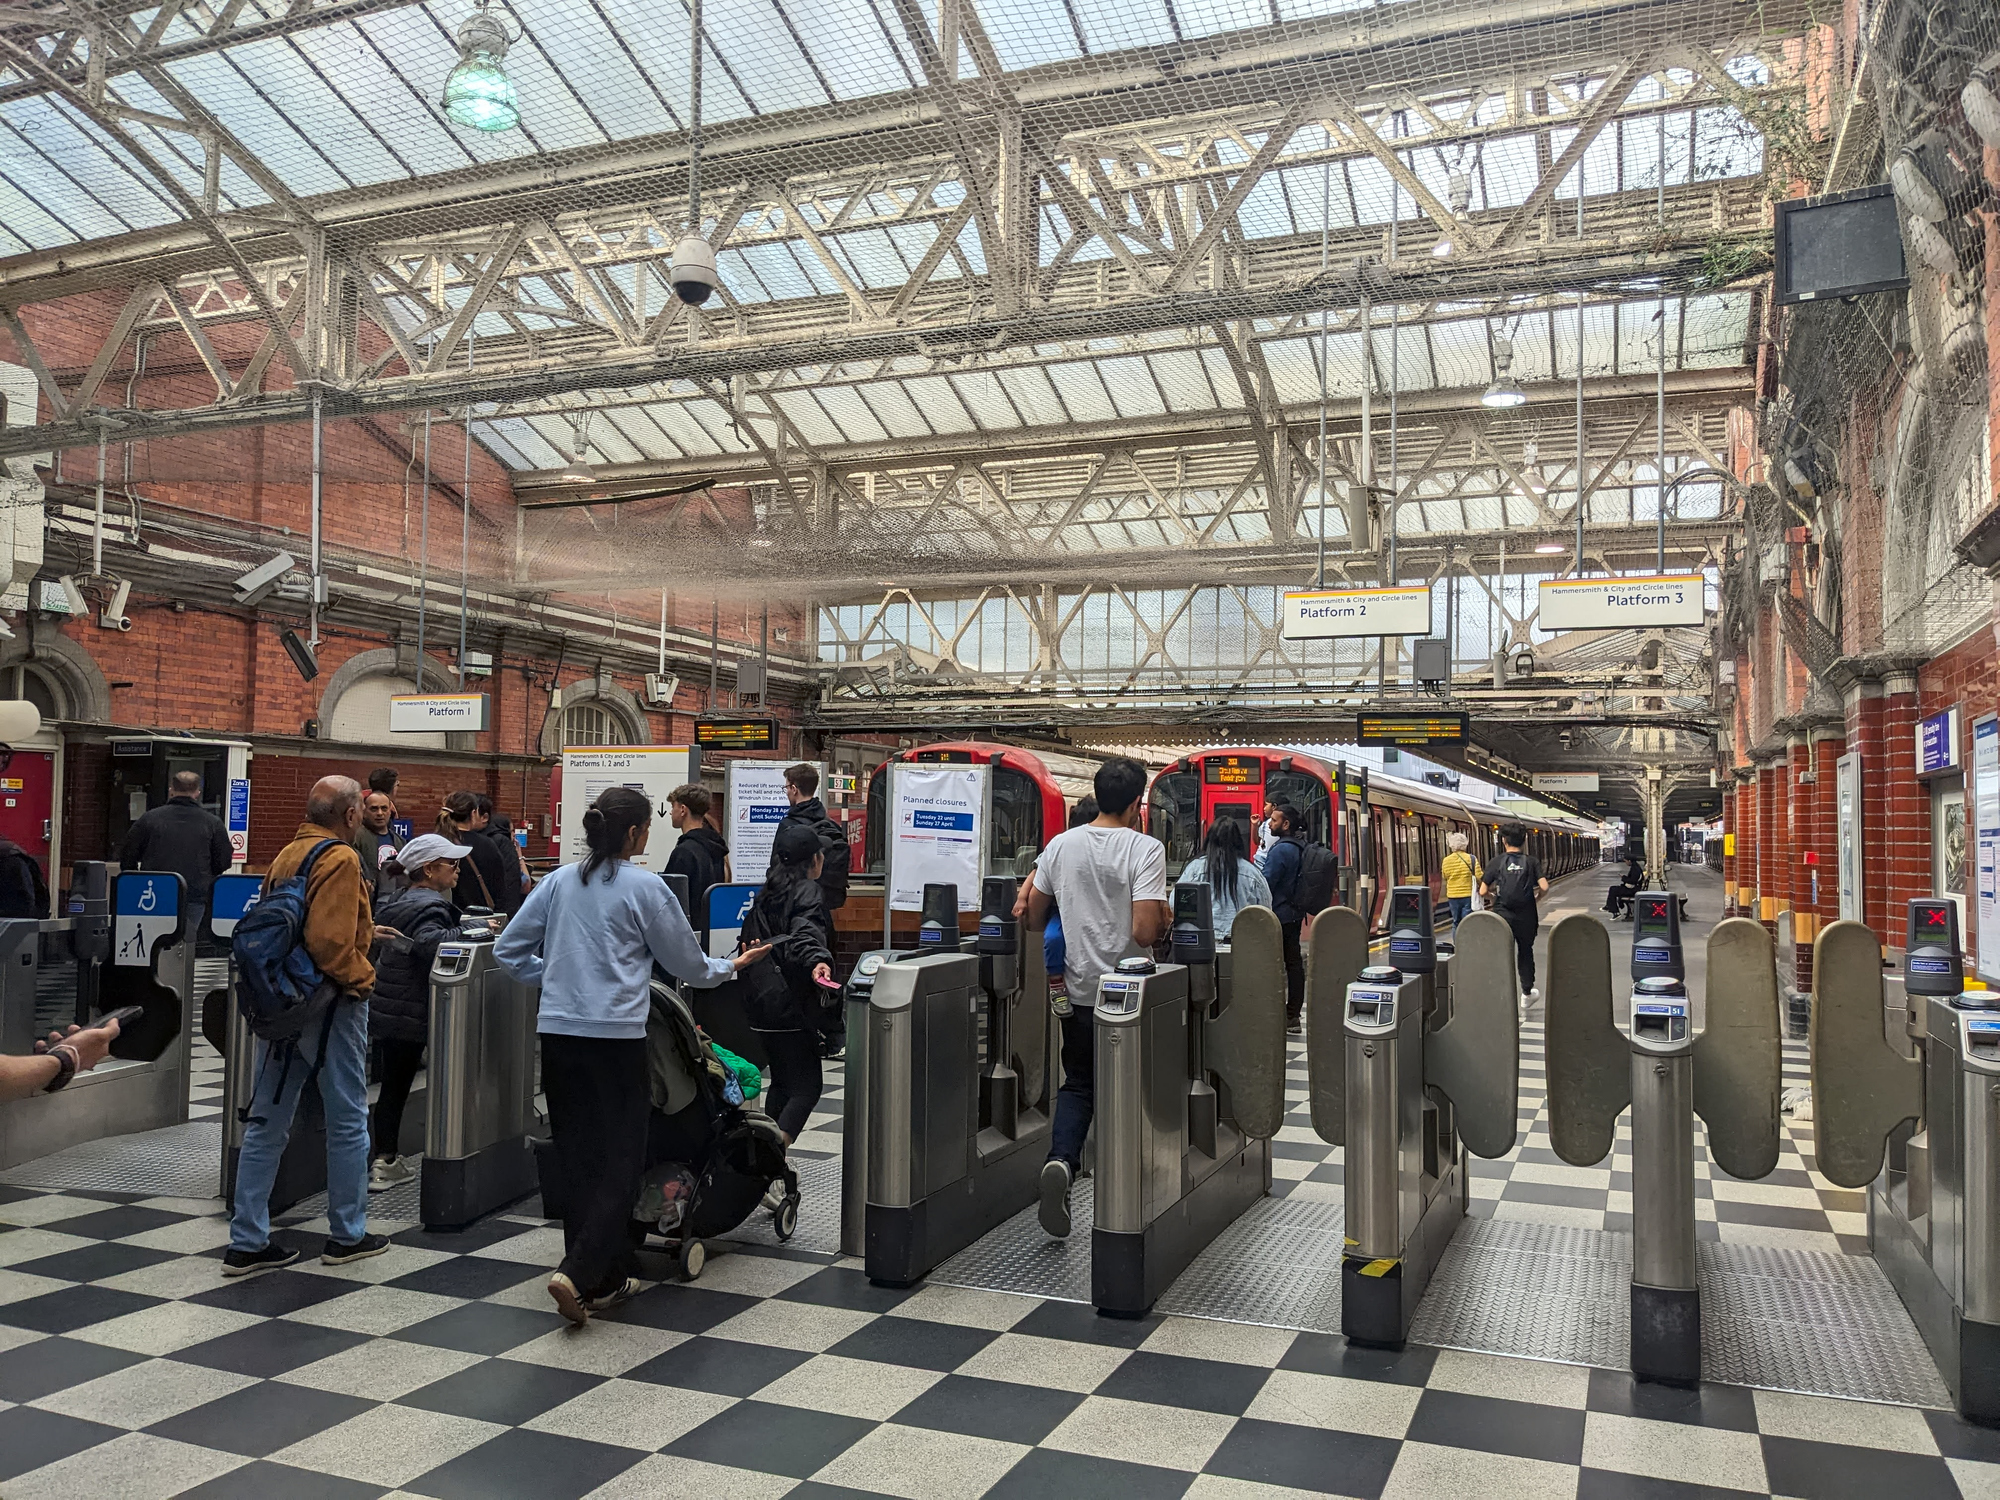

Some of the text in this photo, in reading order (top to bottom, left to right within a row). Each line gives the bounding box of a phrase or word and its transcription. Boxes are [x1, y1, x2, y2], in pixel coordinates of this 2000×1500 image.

[1552, 586, 1602, 594] Hammersmith
[1607, 592, 1683, 606] Platform 3
[1300, 606, 1366, 618] Platform 2
[429, 708, 464, 716] Platform
[903, 796, 967, 806] Planned closures
[394, 824, 408, 836] TH
